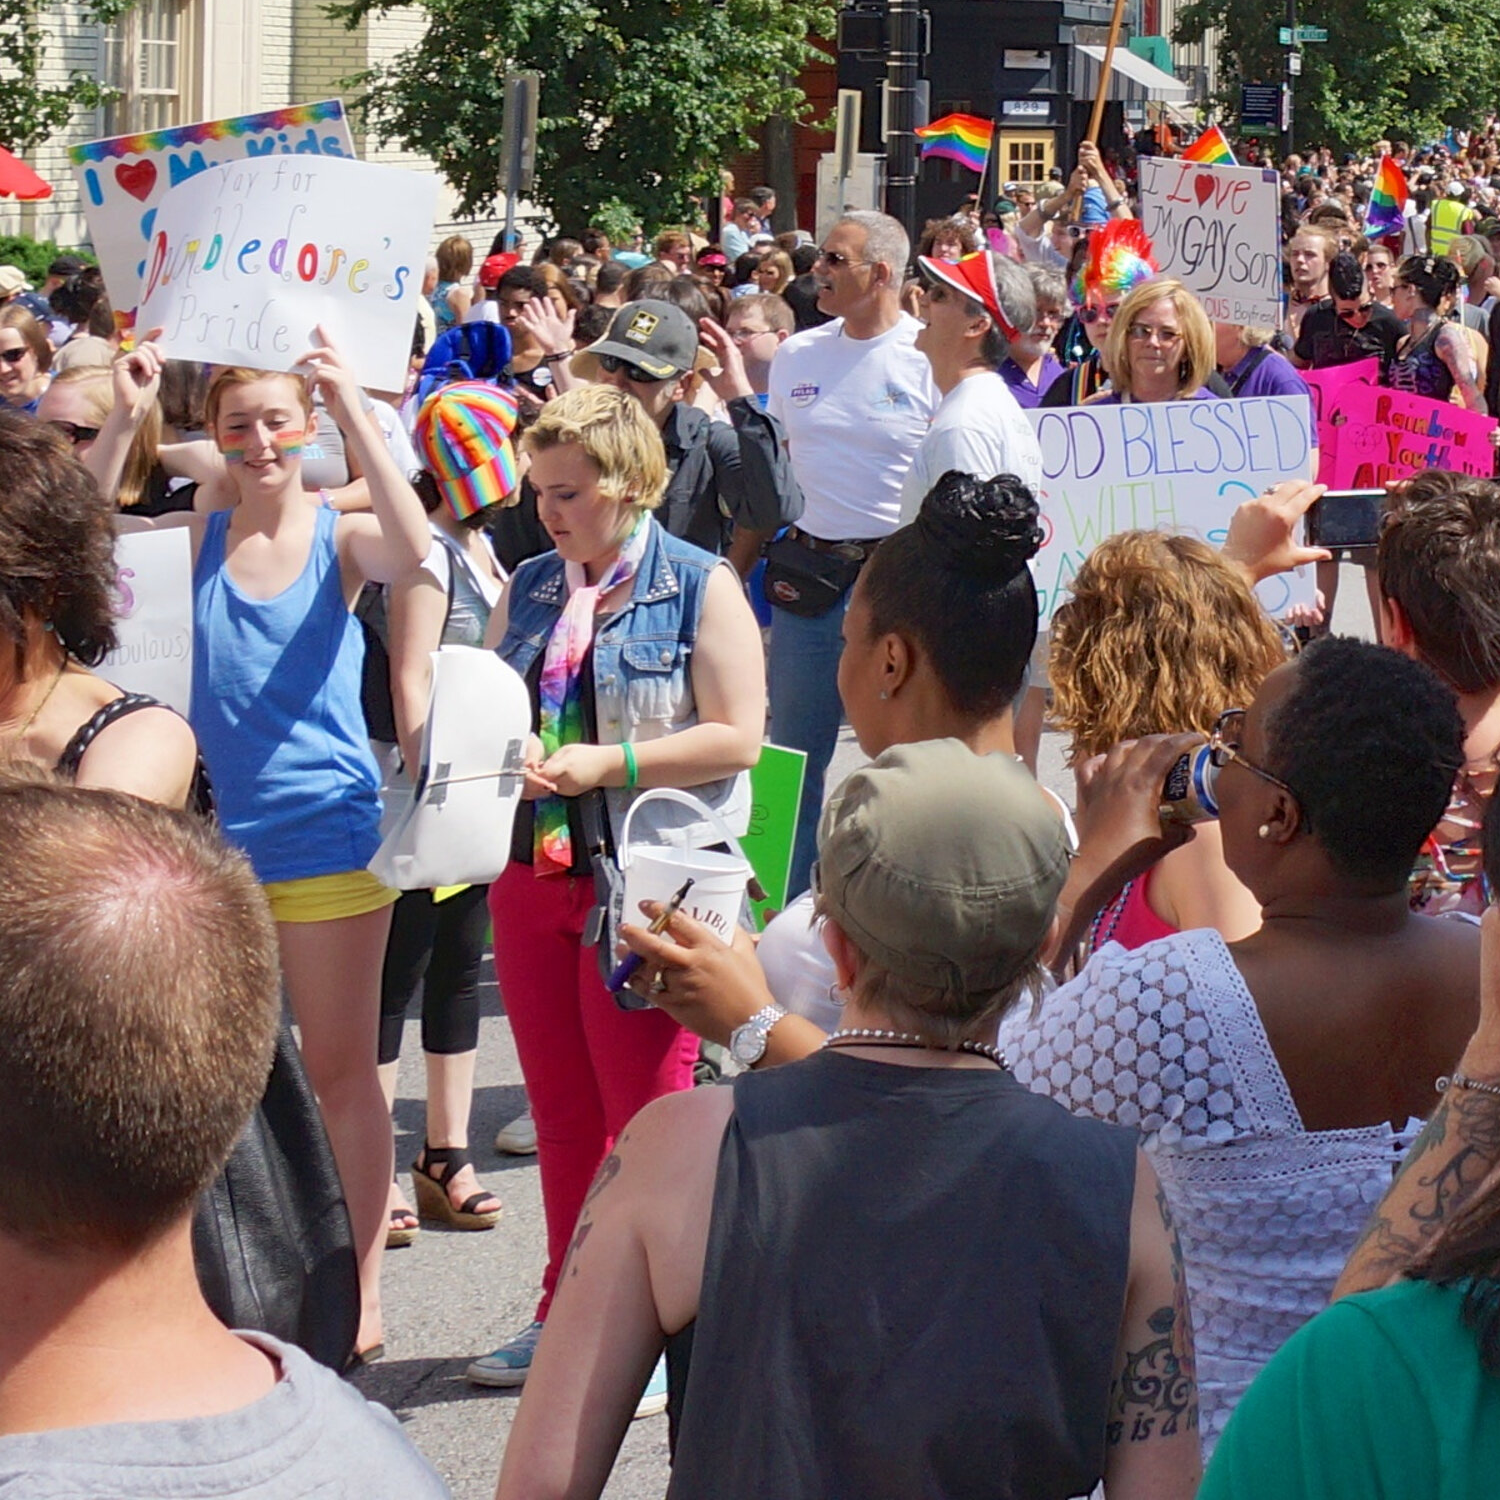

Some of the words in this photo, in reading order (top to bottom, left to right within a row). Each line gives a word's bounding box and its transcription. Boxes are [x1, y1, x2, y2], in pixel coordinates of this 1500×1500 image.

[1014, 102, 1039, 112] 829
[84, 168, 104, 206] I
[272, 159, 317, 194] for
[1141, 162, 1163, 195] I
[168, 294, 292, 353] Pride
[1037, 411, 1105, 479] OD
[1119, 399, 1307, 478] BLESSED
[1376, 395, 1467, 447] Rainbow
[1062, 480, 1176, 546] WITH
[680, 906, 728, 936] LIBU
